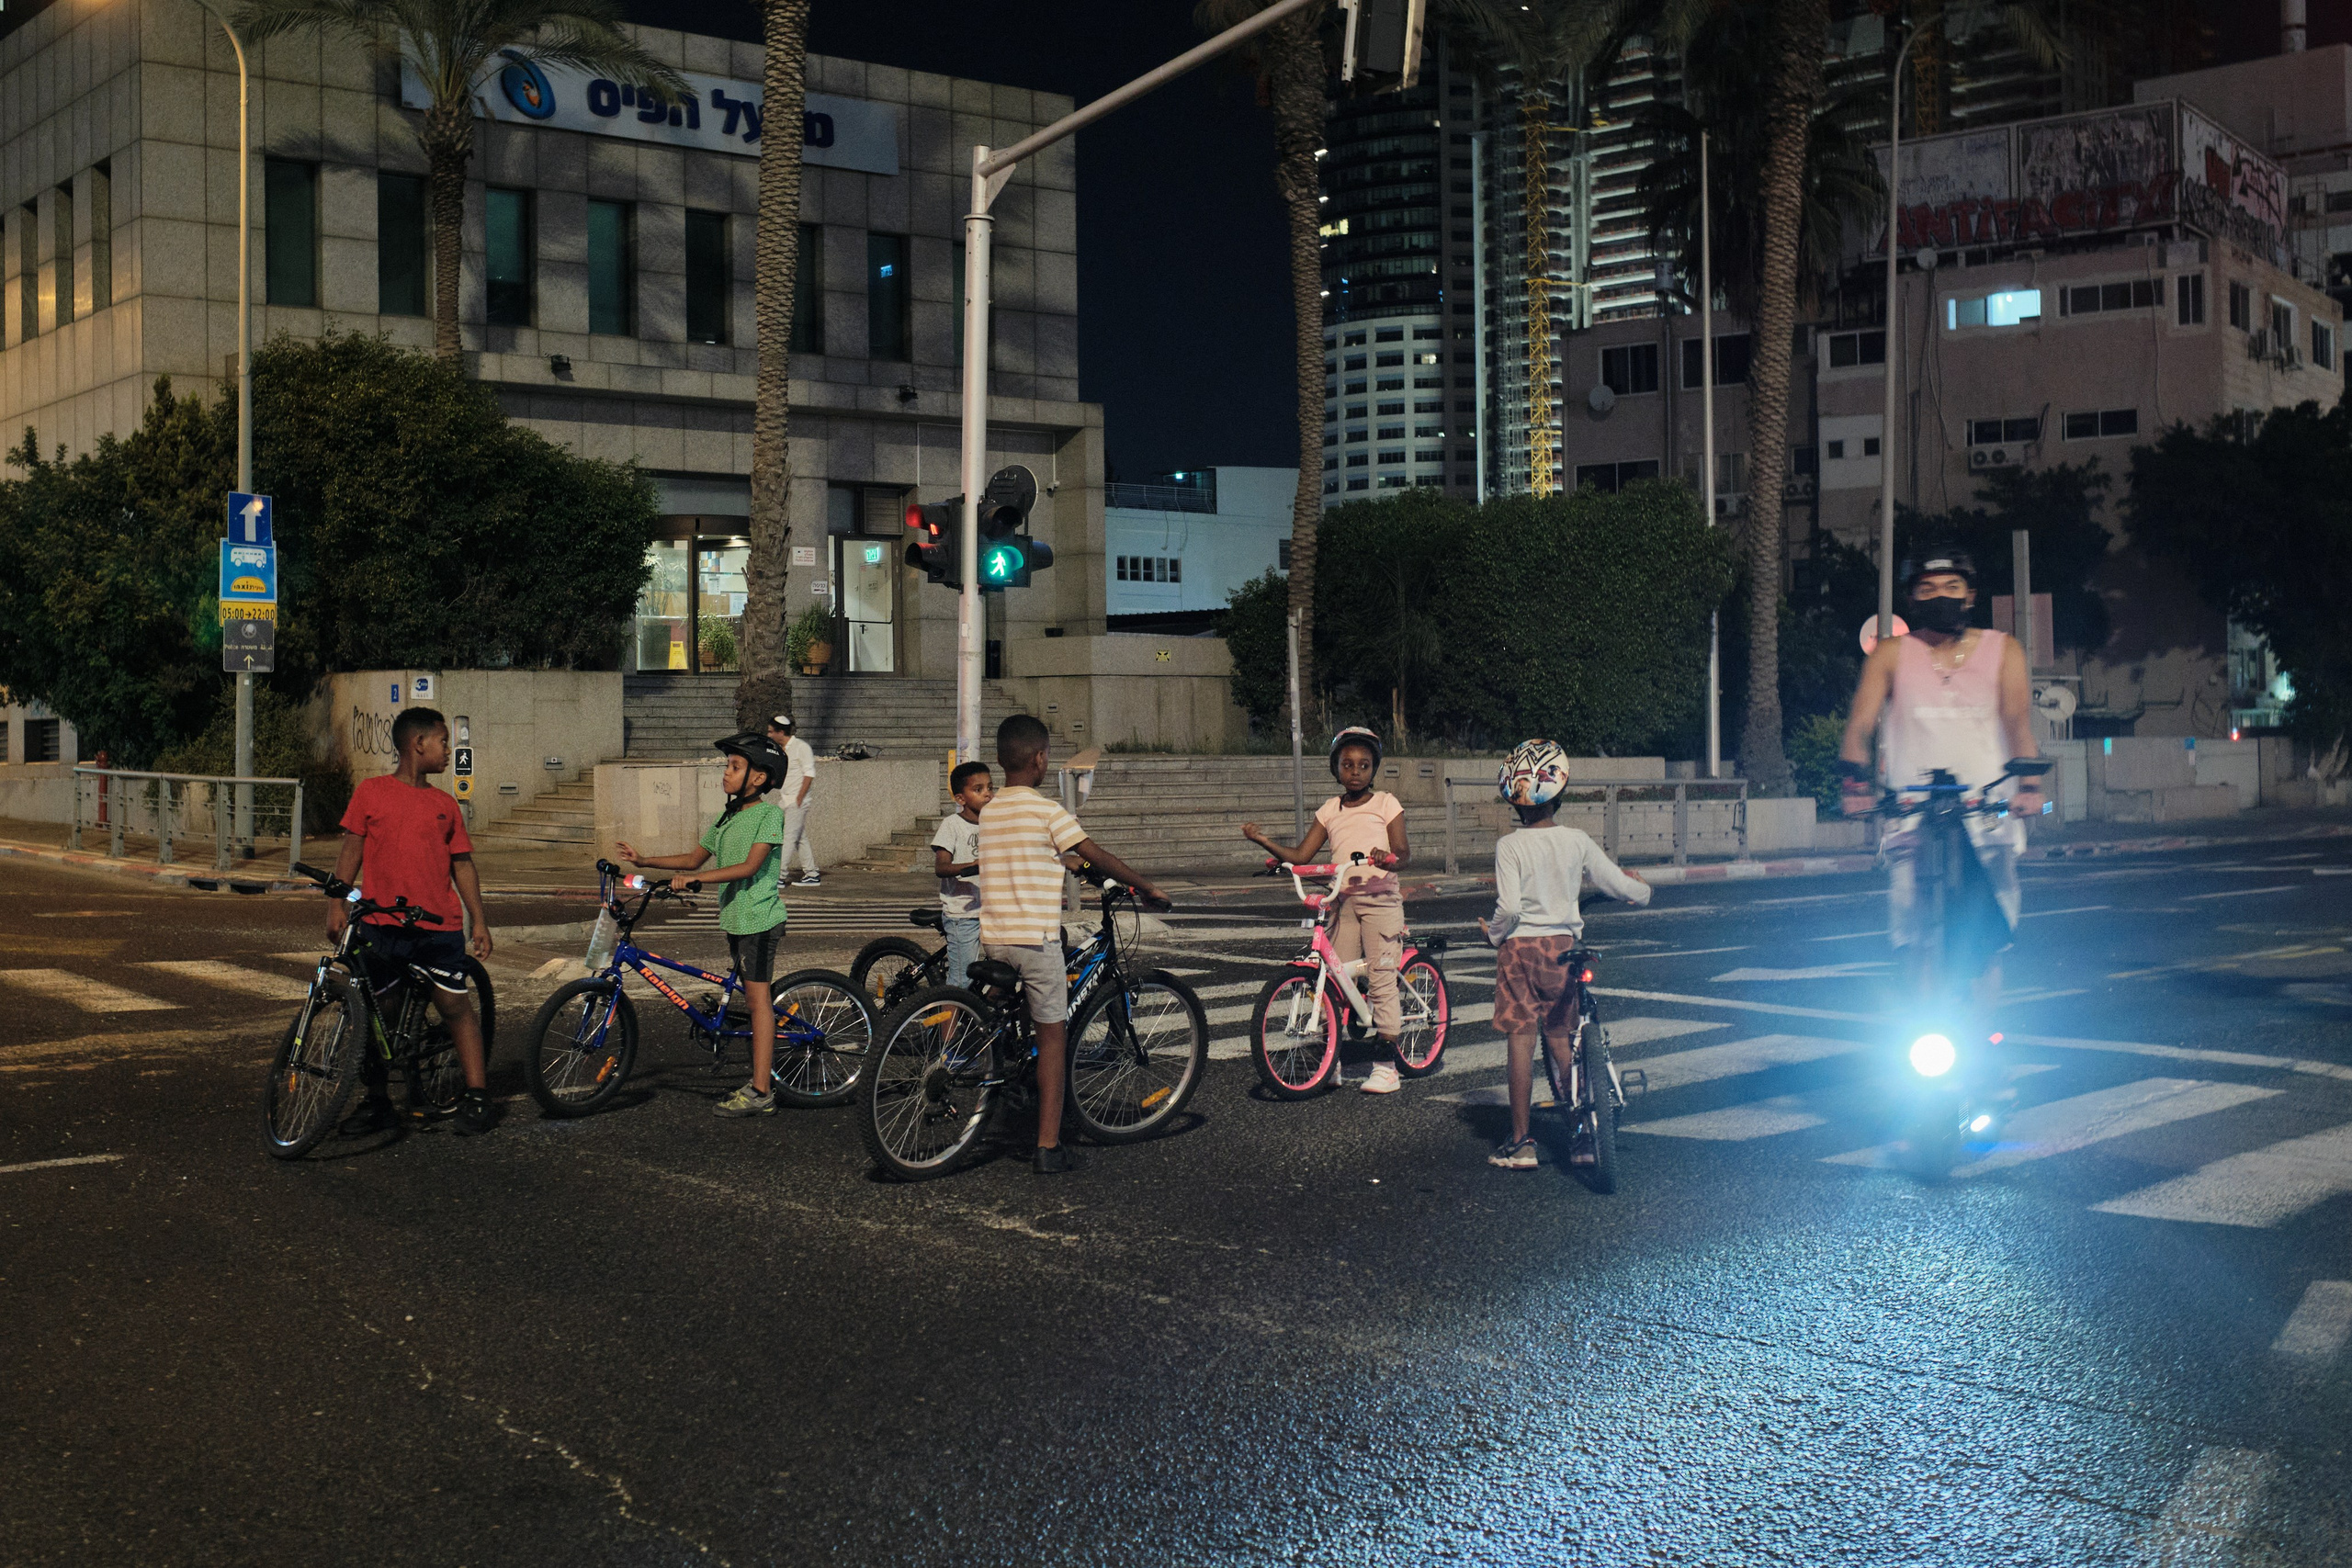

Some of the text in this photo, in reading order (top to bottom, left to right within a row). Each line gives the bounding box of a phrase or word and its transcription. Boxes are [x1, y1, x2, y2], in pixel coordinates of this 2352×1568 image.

[587, 78, 835, 148] מעל הפיס
[222, 607, 275, 620] 05:00 22:00
[639, 966, 690, 1010] Raleigh
